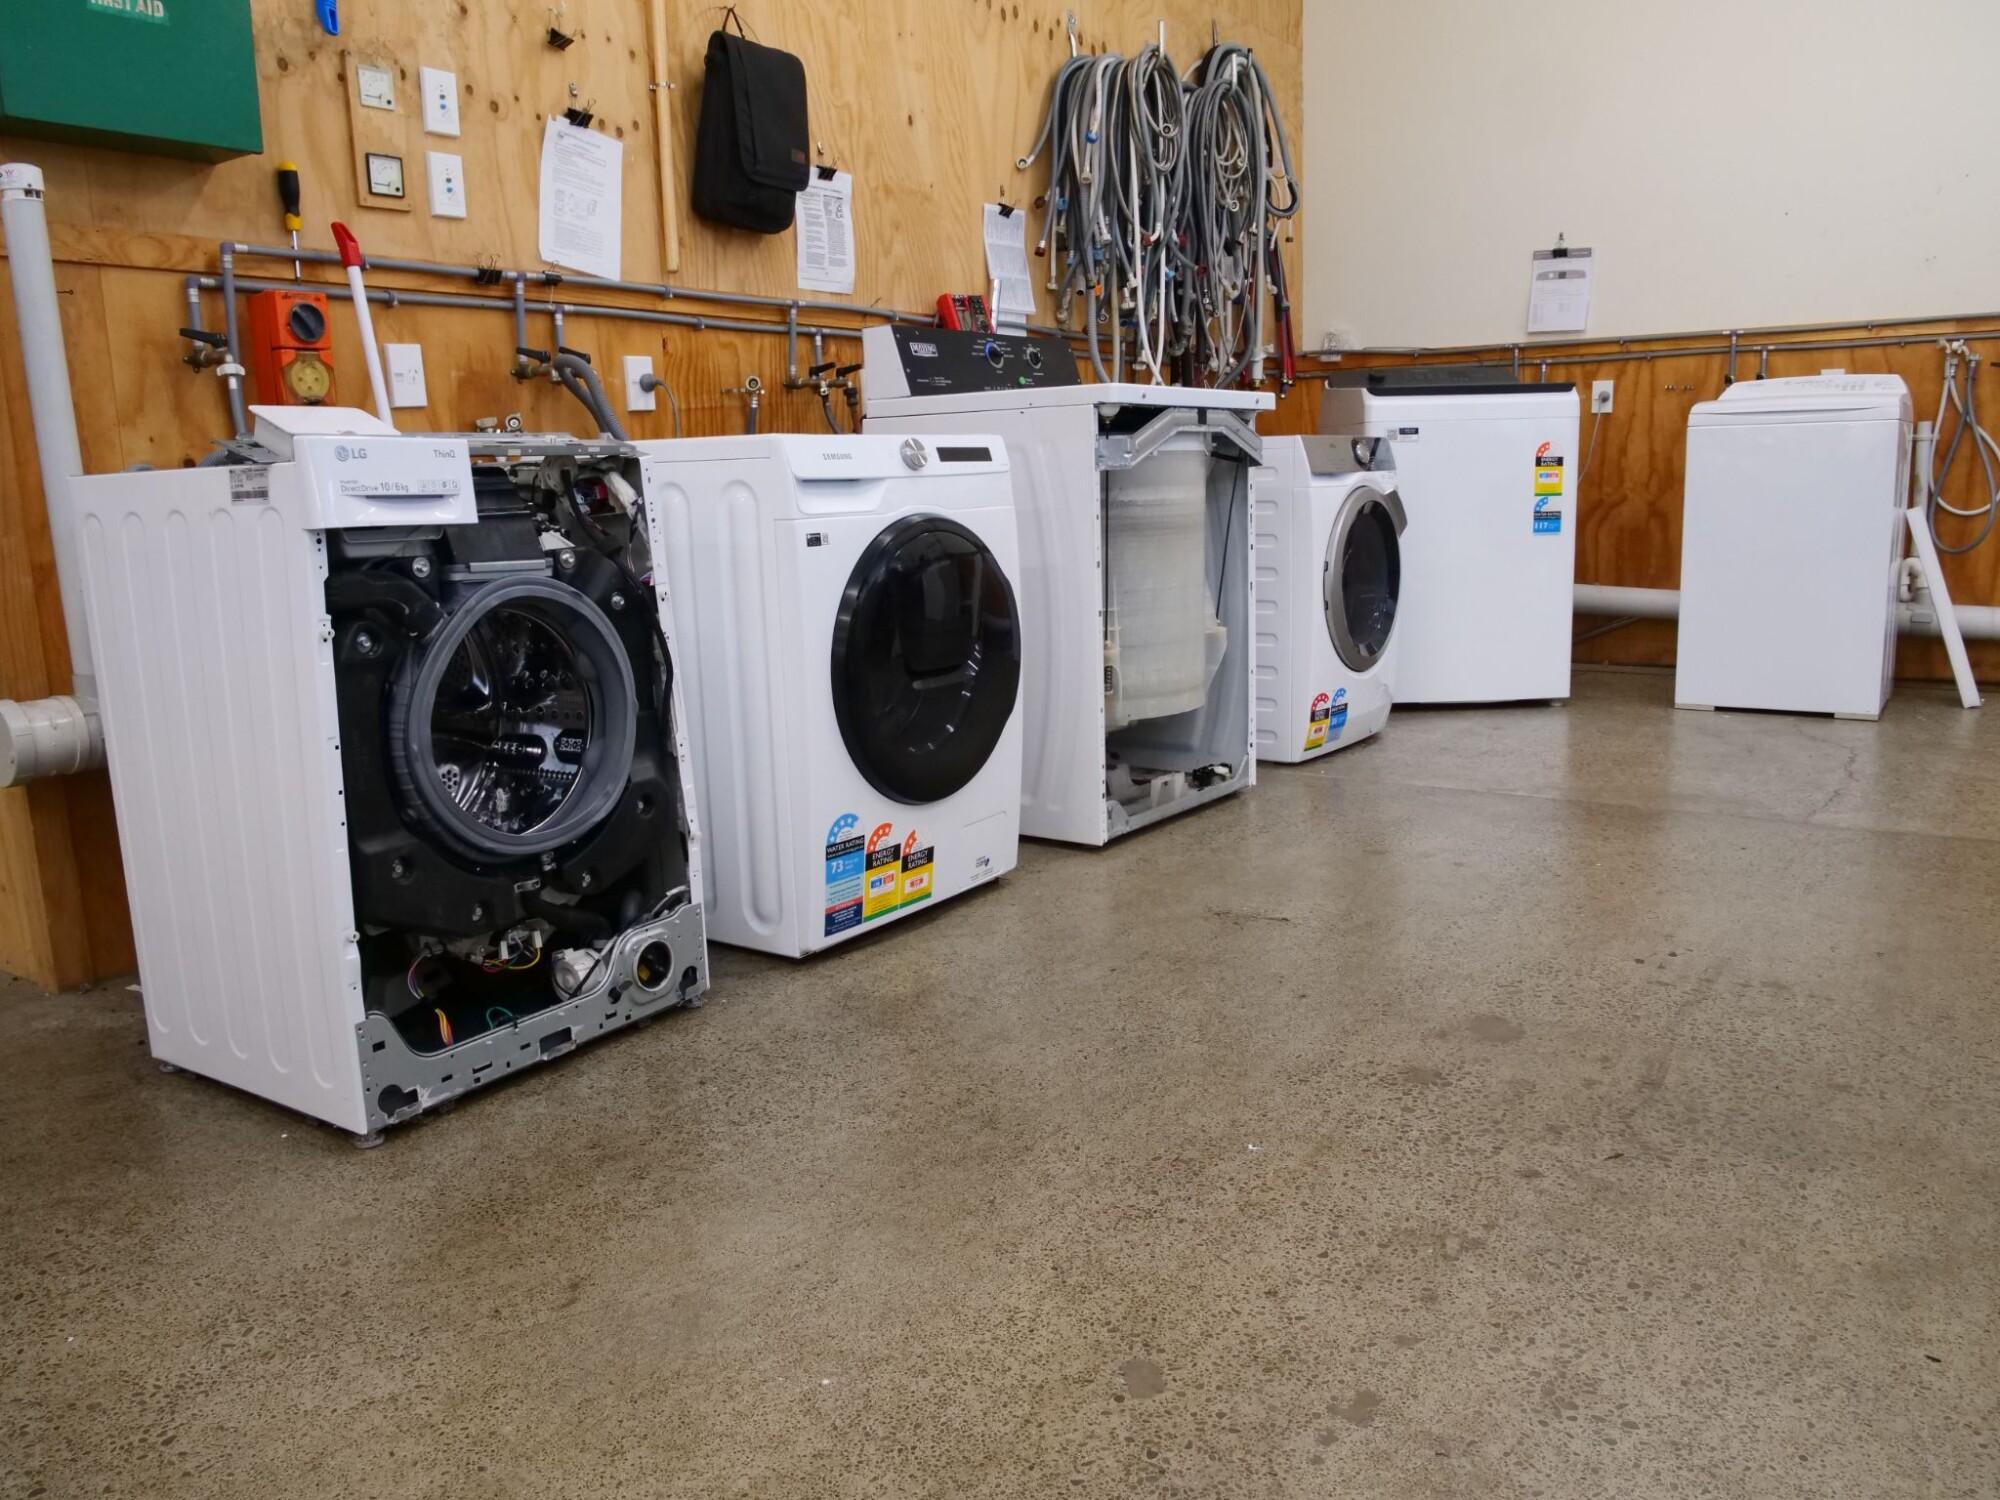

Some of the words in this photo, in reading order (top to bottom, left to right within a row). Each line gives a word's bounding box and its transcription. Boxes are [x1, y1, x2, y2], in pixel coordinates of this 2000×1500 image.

[352, 449, 367, 459] LG
[434, 449, 456, 459] ThinQ
[827, 843, 845, 854] WATER
[845, 838, 864, 849] RATING
[872, 847, 895, 860] ENERGY
[908, 850, 928, 863] ENERGY
[831, 860, 844, 874] 73
[872, 855, 894, 867] RATING
[908, 857, 928, 870] RATING
